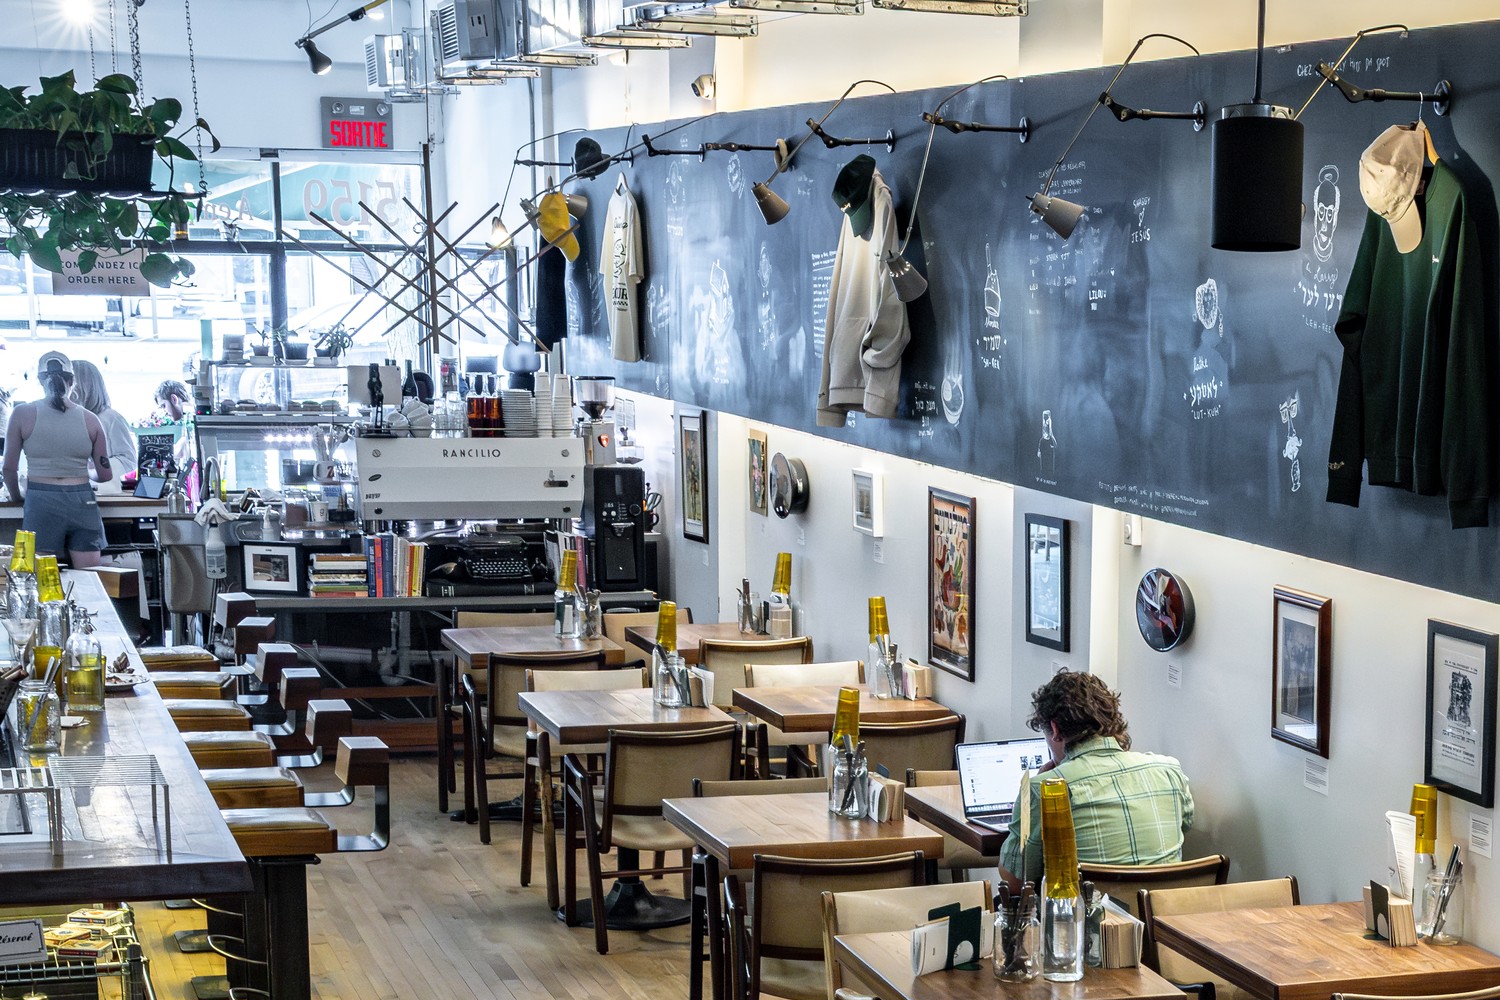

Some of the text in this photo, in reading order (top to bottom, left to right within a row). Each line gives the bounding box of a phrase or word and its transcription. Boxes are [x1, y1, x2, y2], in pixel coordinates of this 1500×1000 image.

[330, 120, 388, 147] SORTIE
[68, 275, 139, 285] ORDER HERE
[442, 449, 502, 458] RANCILIO
